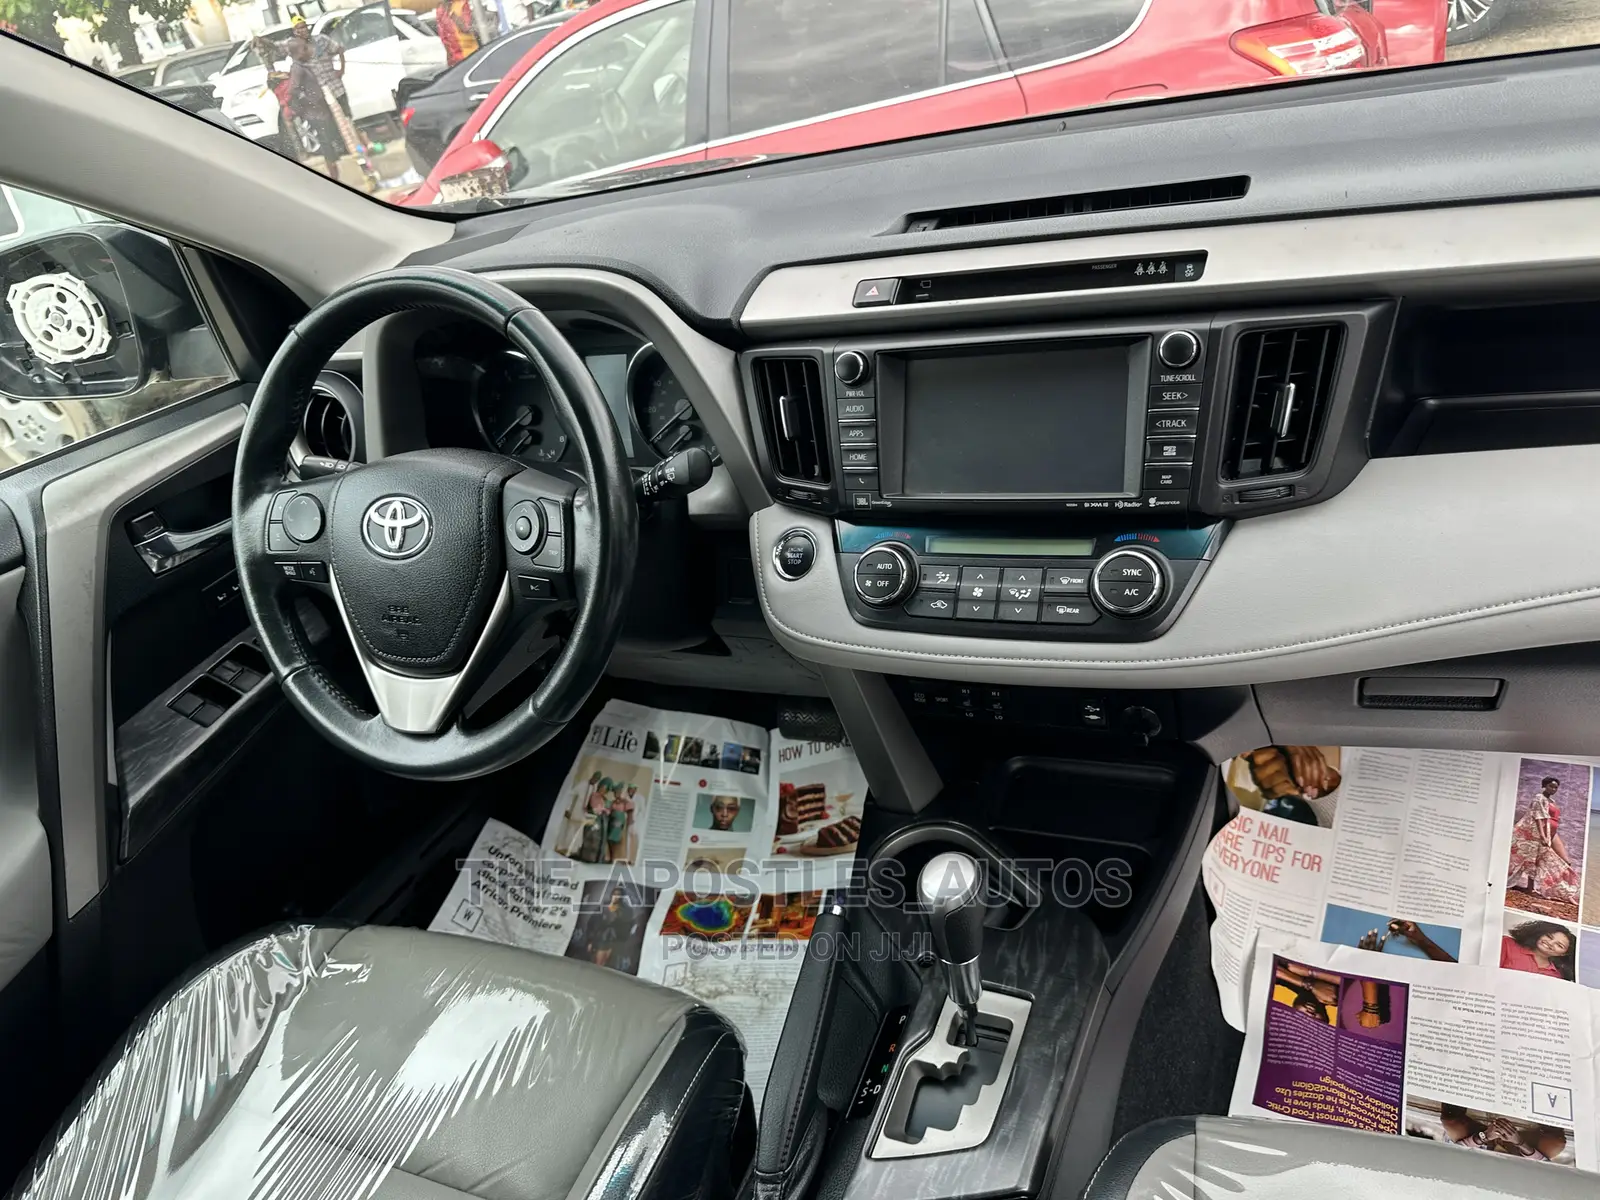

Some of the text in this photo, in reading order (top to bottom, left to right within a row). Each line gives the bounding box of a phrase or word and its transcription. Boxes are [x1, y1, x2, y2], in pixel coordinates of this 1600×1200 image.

[846, 404, 864, 412] AUDIO
[1122, 568, 1142, 576] SYNC
[1124, 588, 1139, 596] A/C
[601, 726, 639, 754] Life
[778, 744, 804, 763] HOW
[1257, 822, 1292, 847] NAIL
[1250, 839, 1286, 865] TIPS
[1292, 850, 1322, 874] FOR
[1213, 842, 1282, 886] EVERYONE
[462, 910, 474, 922] W
[510, 905, 562, 931] Premiere
[898, 1015, 906, 1025] P
[888, 1043, 896, 1052] R
[880, 1064, 890, 1074] N
[1291, 1080, 1346, 1099] Bland2Glam
[1319, 1075, 1398, 1113] Holiday Campaign
[1282, 1097, 1292, 1105] in
[1292, 1099, 1311, 1108] love
[1346, 1094, 1355, 1103] in
[1547, 1093, 1558, 1108] A
[1274, 1086, 1397, 1128] Nollywood as he dazzles Uzo
[1291, 1107, 1314, 1118] Food
[1311, 1102, 1334, 1112] finds
